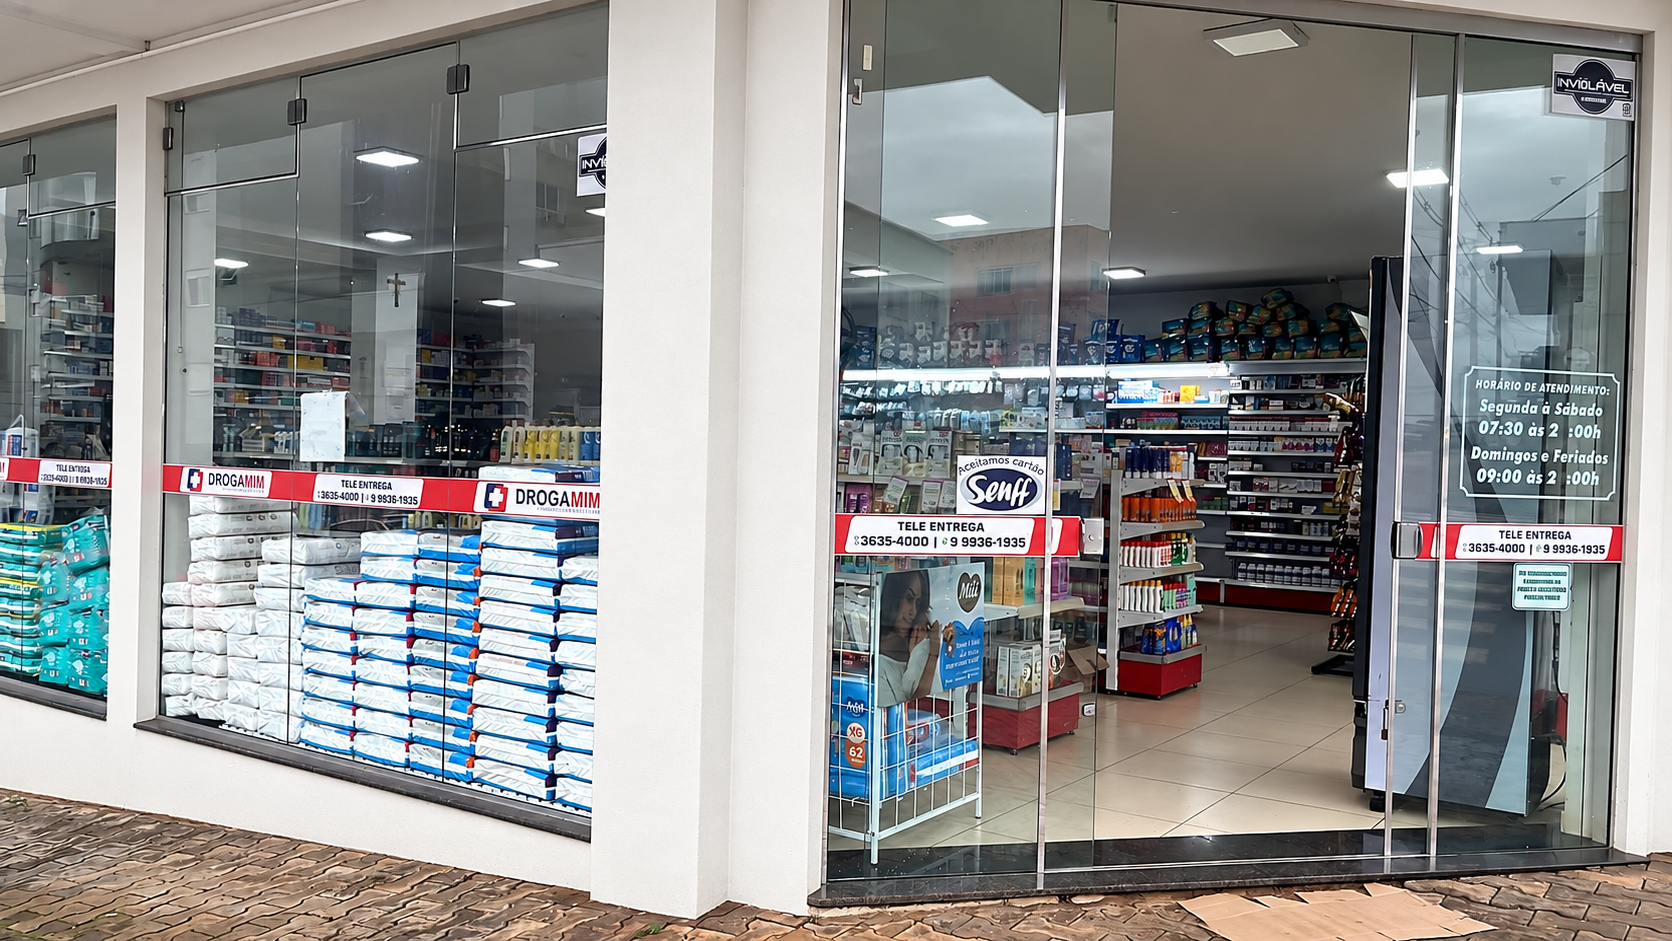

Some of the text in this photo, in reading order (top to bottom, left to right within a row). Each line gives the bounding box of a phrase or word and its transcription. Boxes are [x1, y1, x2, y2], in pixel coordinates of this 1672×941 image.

[1475, 378, 1610, 396] HORÁRIO DE ATENDIMENTO:
[1479, 399, 1538, 416] Segunda
[1554, 402, 1603, 417] Sábado
[1478, 420, 1524, 436] 07:30
[1528, 422, 1545, 437] às
[1471, 446, 1609, 465] Domingos e Feriados
[958, 457, 1045, 476] Aceitamos cartão
[208, 472, 265, 489] DROGAMIM
[341, 479, 392, 490] TELE ENTREGA
[1476, 468, 1522, 484] 09:00
[1526, 469, 1543, 485] às
[515, 488, 600, 509] DROGAMIM
[967, 474, 1033, 507] Senff
[897, 521, 985, 532] TELE ENTREGA
[1499, 530, 1572, 540] TELE ENTREGA
[860, 535, 929, 547] 3635-4000
[950, 537, 958, 547] 9
[961, 537, 1026, 548] 9936-1935
[1468, 543, 1525, 553] 3635-4000
[1543, 544, 1550, 554] 9
[1552, 544, 1606, 554] 9936-1935
[849, 726, 863, 738] XG
[849, 746, 863, 759] 62
